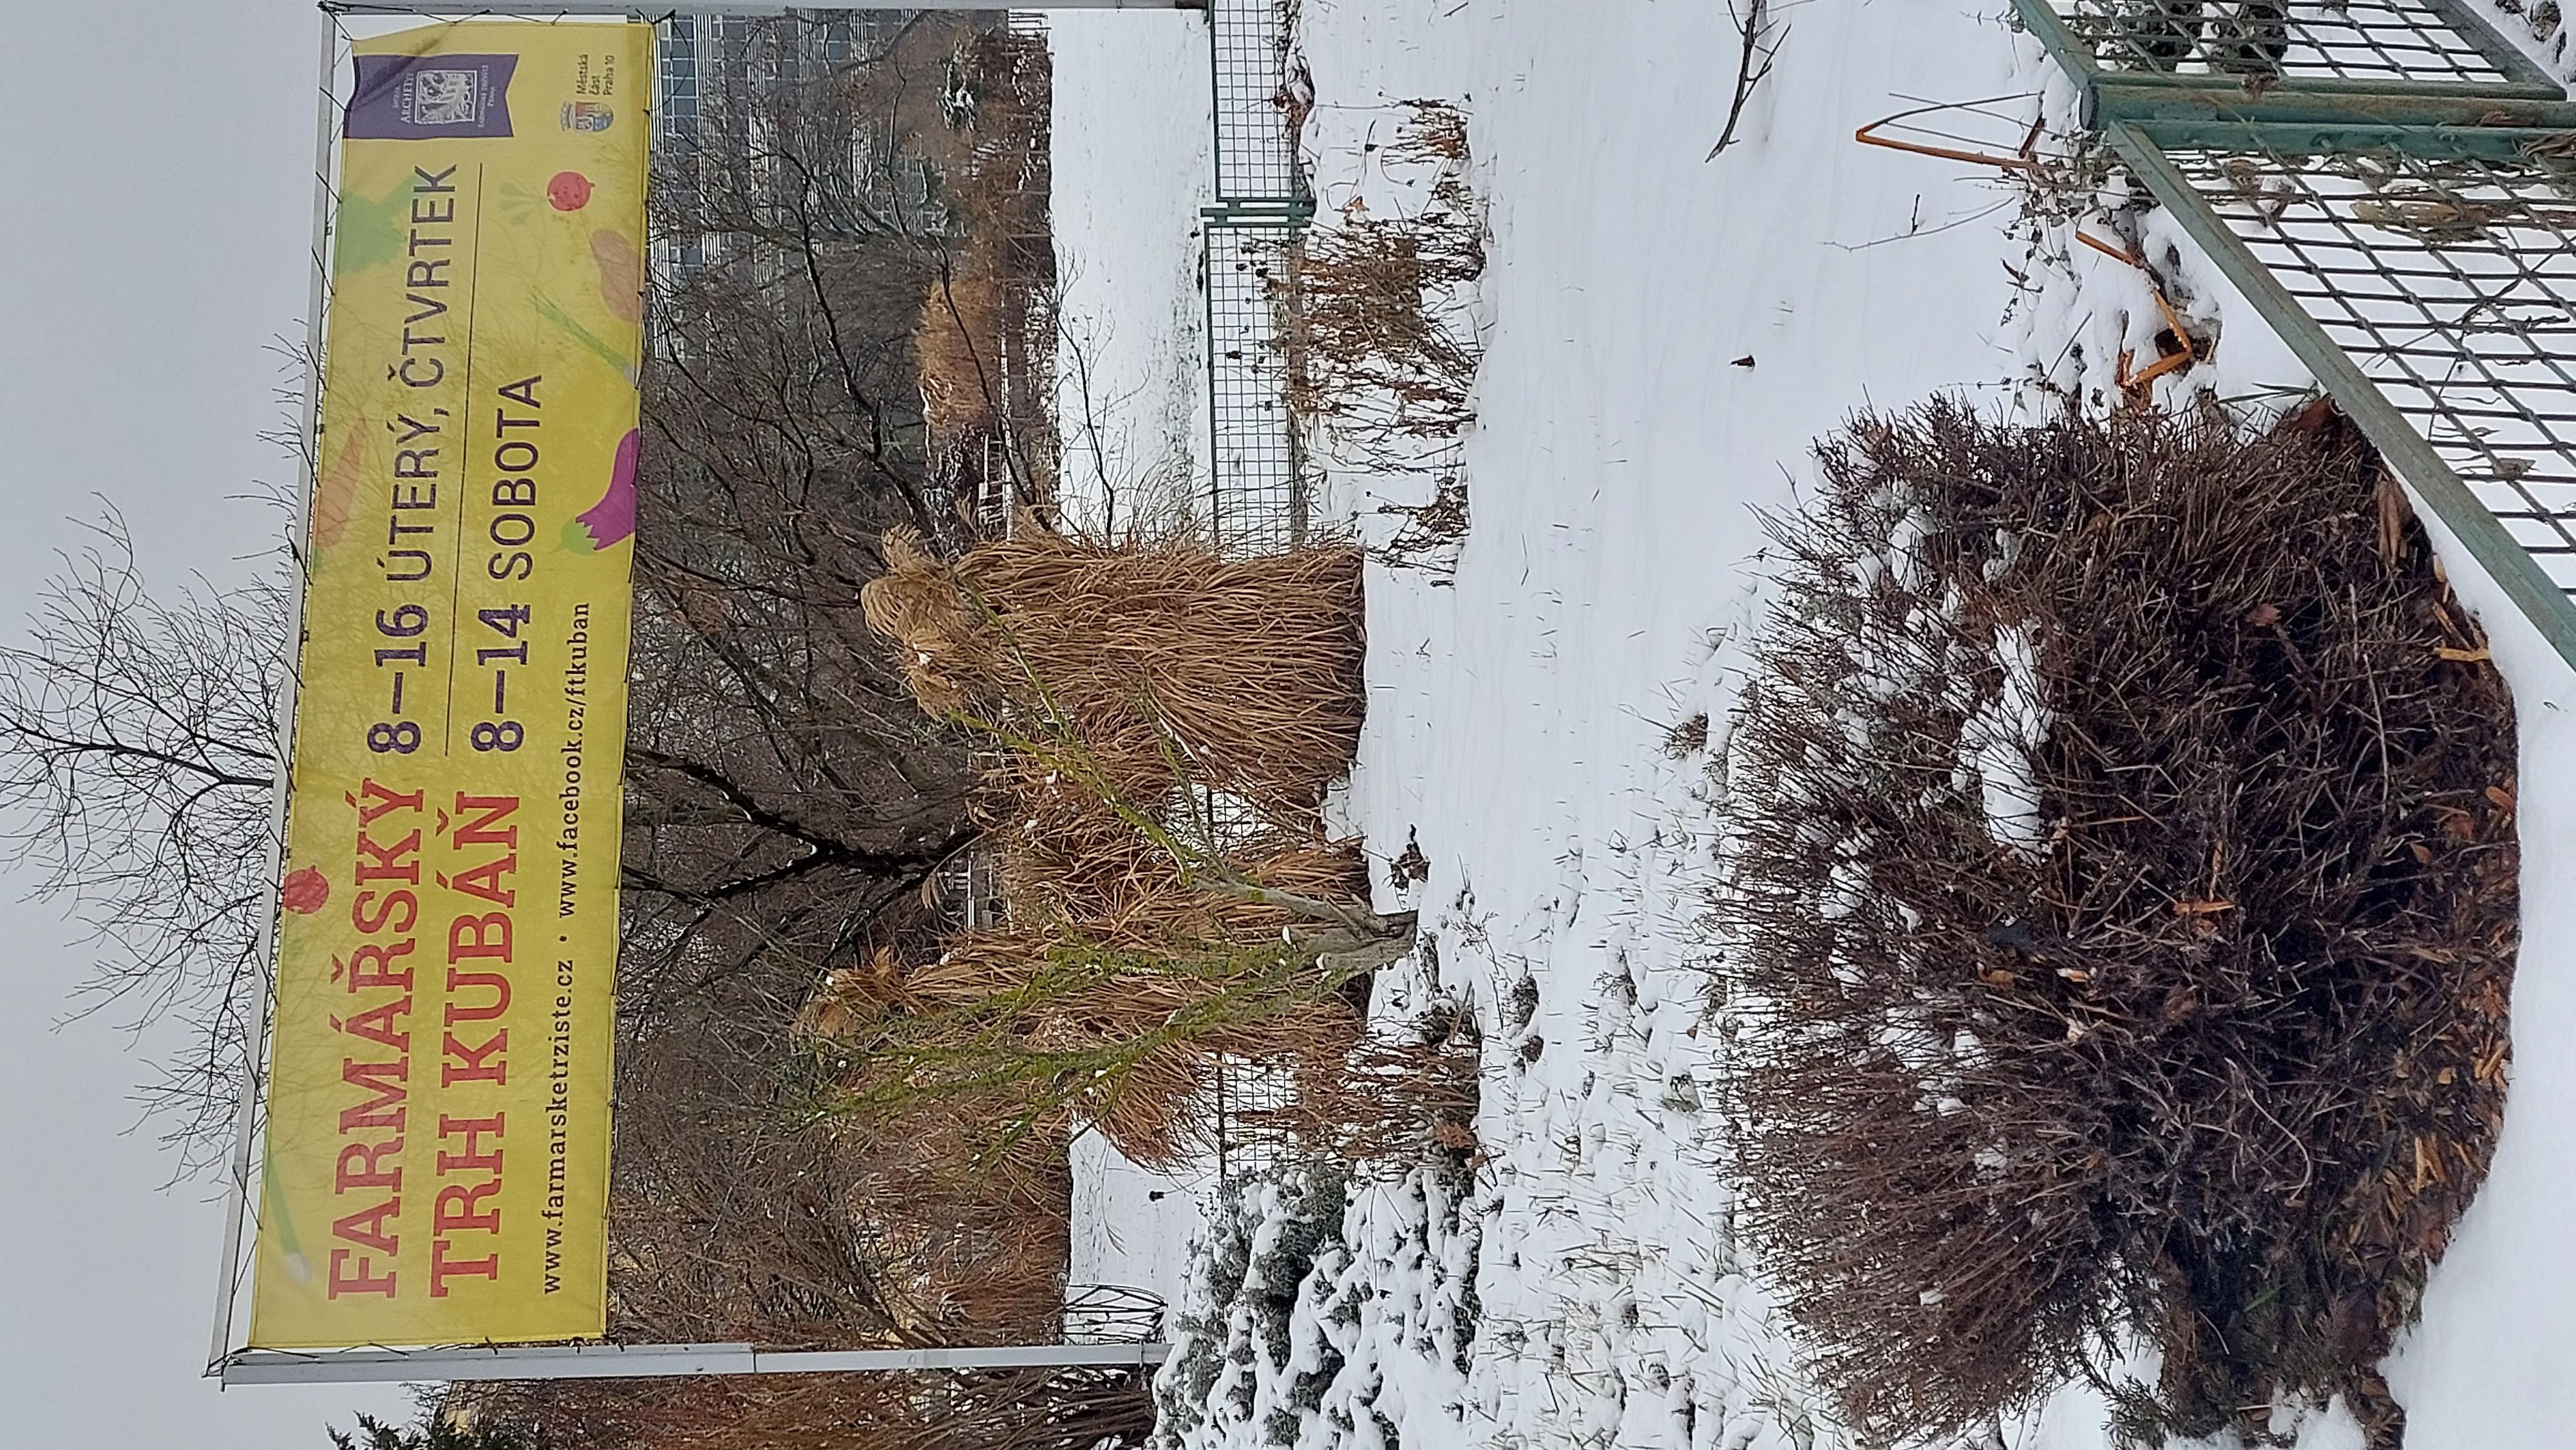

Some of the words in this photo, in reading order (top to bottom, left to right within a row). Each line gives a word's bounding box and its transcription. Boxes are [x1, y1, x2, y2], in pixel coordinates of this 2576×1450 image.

[576, 54, 588, 94] Městská
[603, 67, 614, 95] Praha
[605, 55, 614, 65] 10
[387, 164, 457, 388] ČTVRTEK
[377, 407, 450, 581] ÚTERÝ,
[488, 375, 542, 580] SOBOTA
[556, 603, 590, 918] www.facebook.cz/ftkuban
[328, 777, 424, 1300] FARMÁŘSKÝ
[435, 791, 519, 1088] KUBÁŇ
[430, 1111, 505, 1297] TRH
[540, 959, 574, 1295] www.farmarsketrziste.cz
